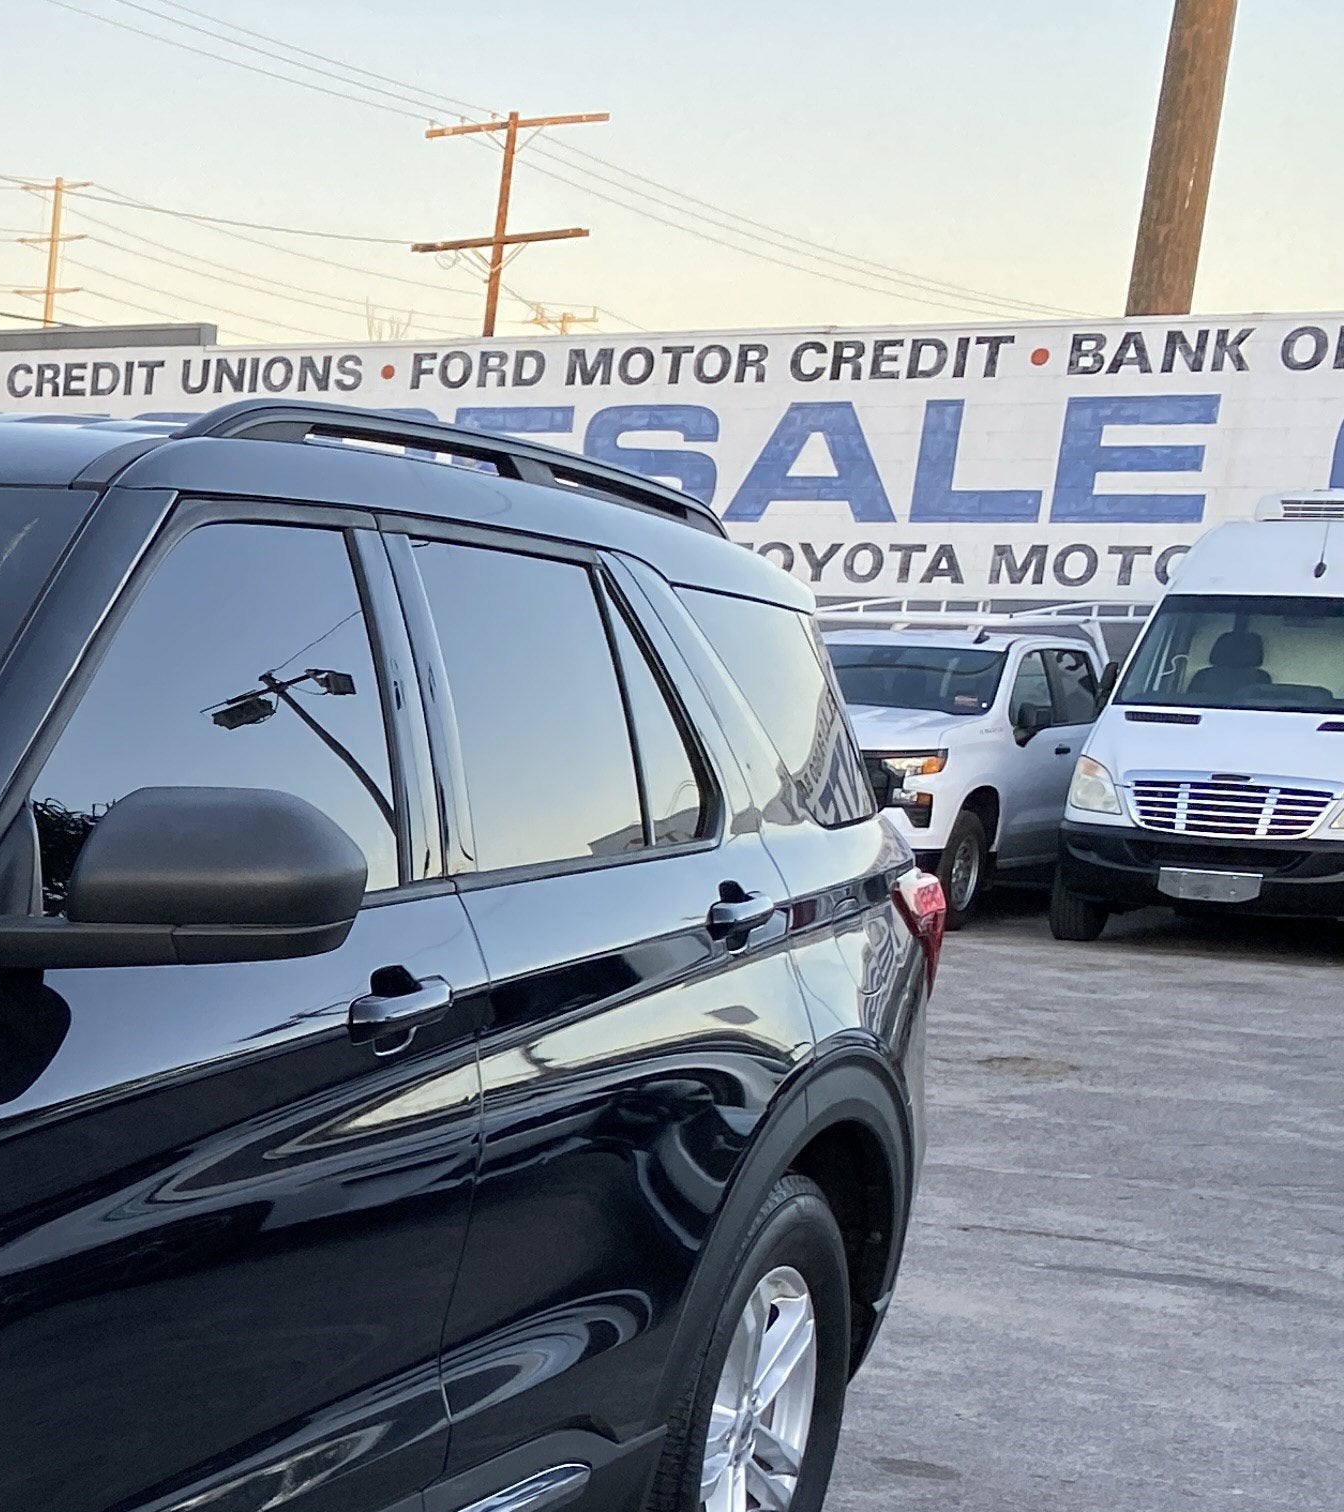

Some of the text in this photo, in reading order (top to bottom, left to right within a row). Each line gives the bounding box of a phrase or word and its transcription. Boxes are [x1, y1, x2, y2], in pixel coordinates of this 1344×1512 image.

[5, 360, 165, 399] CREDIT
[180, 354, 364, 395] UNIONS
[410, 348, 546, 390] FORD
[565, 343, 769, 386] MOTOR
[789, 335, 1015, 382] CREDIT
[1066, 327, 1256, 376] BANK
[734, 541, 964, 586] OYOTA
